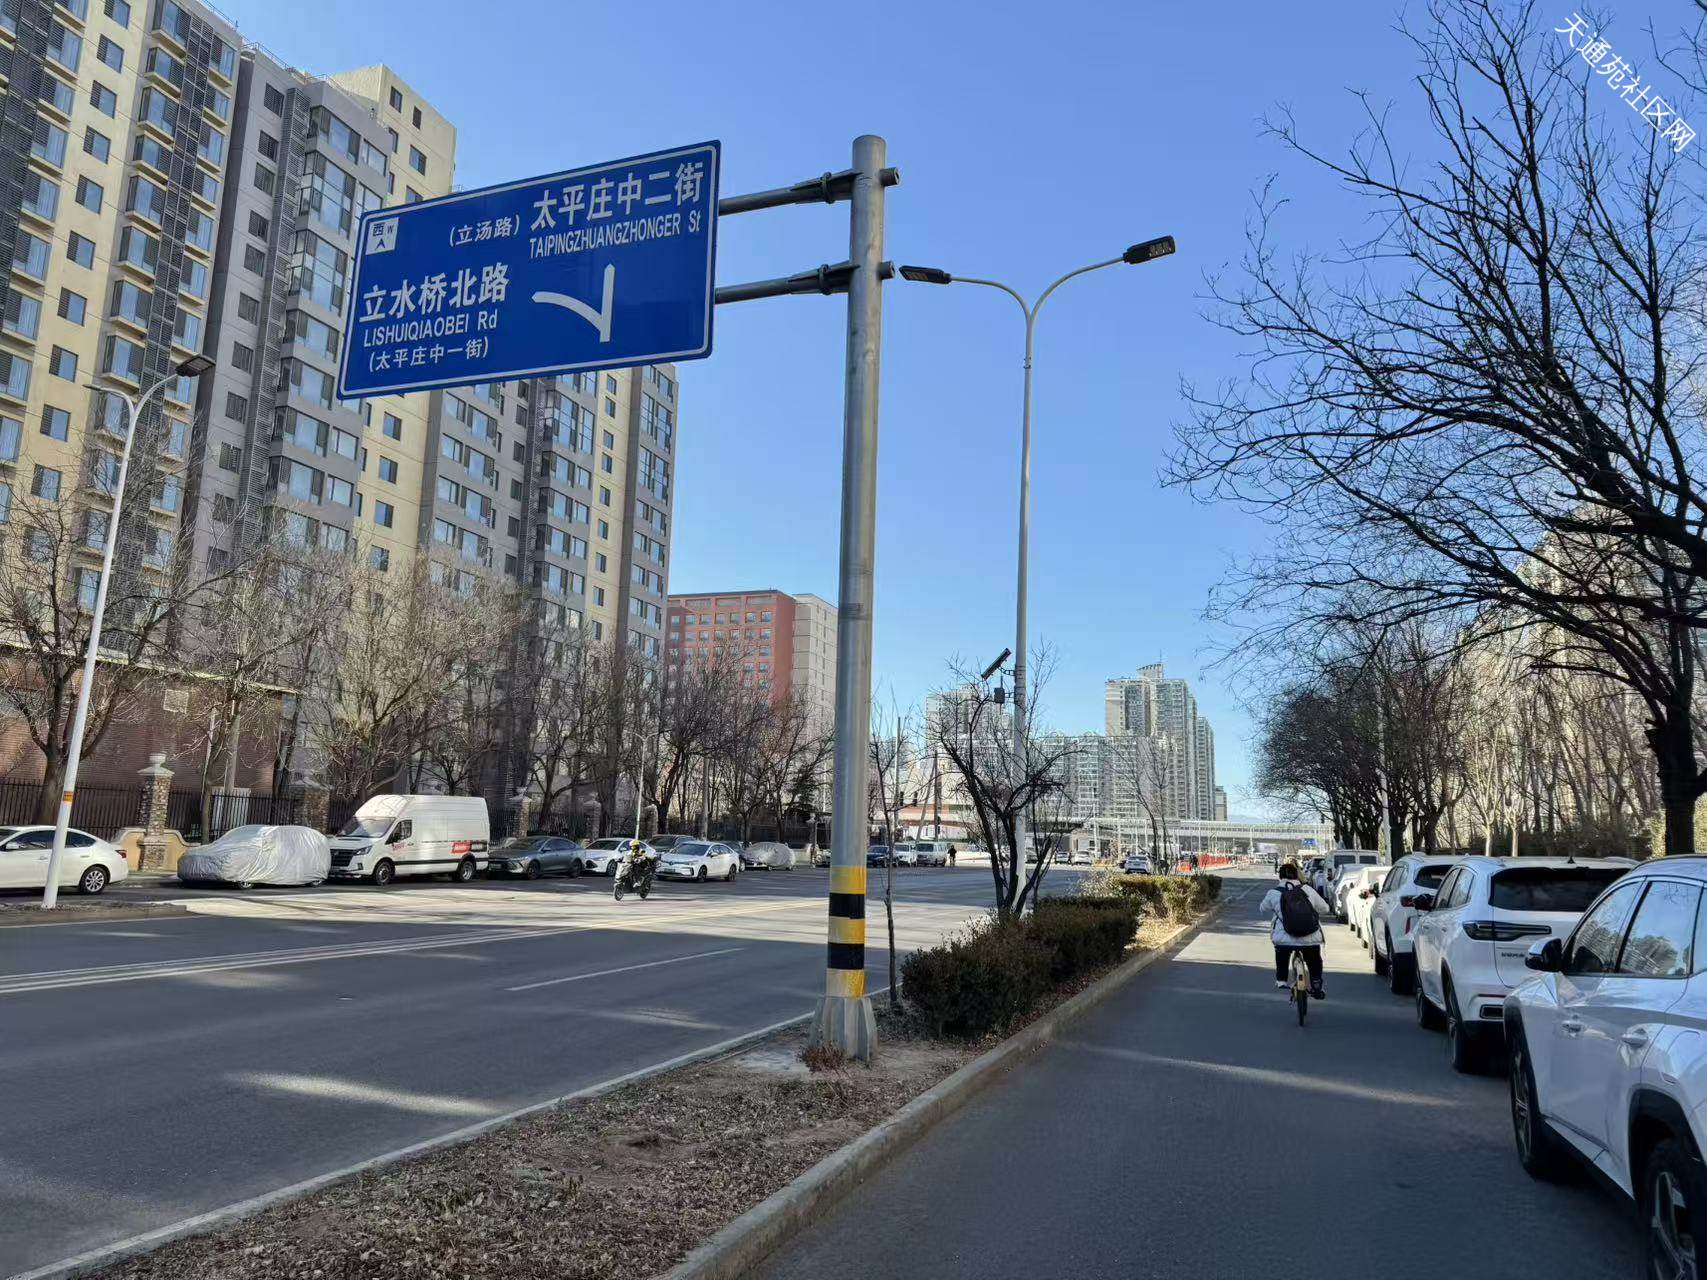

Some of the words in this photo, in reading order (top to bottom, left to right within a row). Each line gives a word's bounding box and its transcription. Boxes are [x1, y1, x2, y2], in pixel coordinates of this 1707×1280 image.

[530, 162, 704, 231] 太平庄中二街
[372, 223, 385, 237] 西
[387, 225, 394, 235] W
[449, 214, 520, 248] (立汤路)
[529, 212, 680, 260] TAIPINGZHUANGZHONGER
[688, 210, 702, 234] St
[359, 262, 510, 323] 立水桥北路
[363, 313, 469, 348] LISHUIQIAOBEI
[477, 309, 498, 332] Rd
[368, 336, 489, 373] (太平庄中一街)
